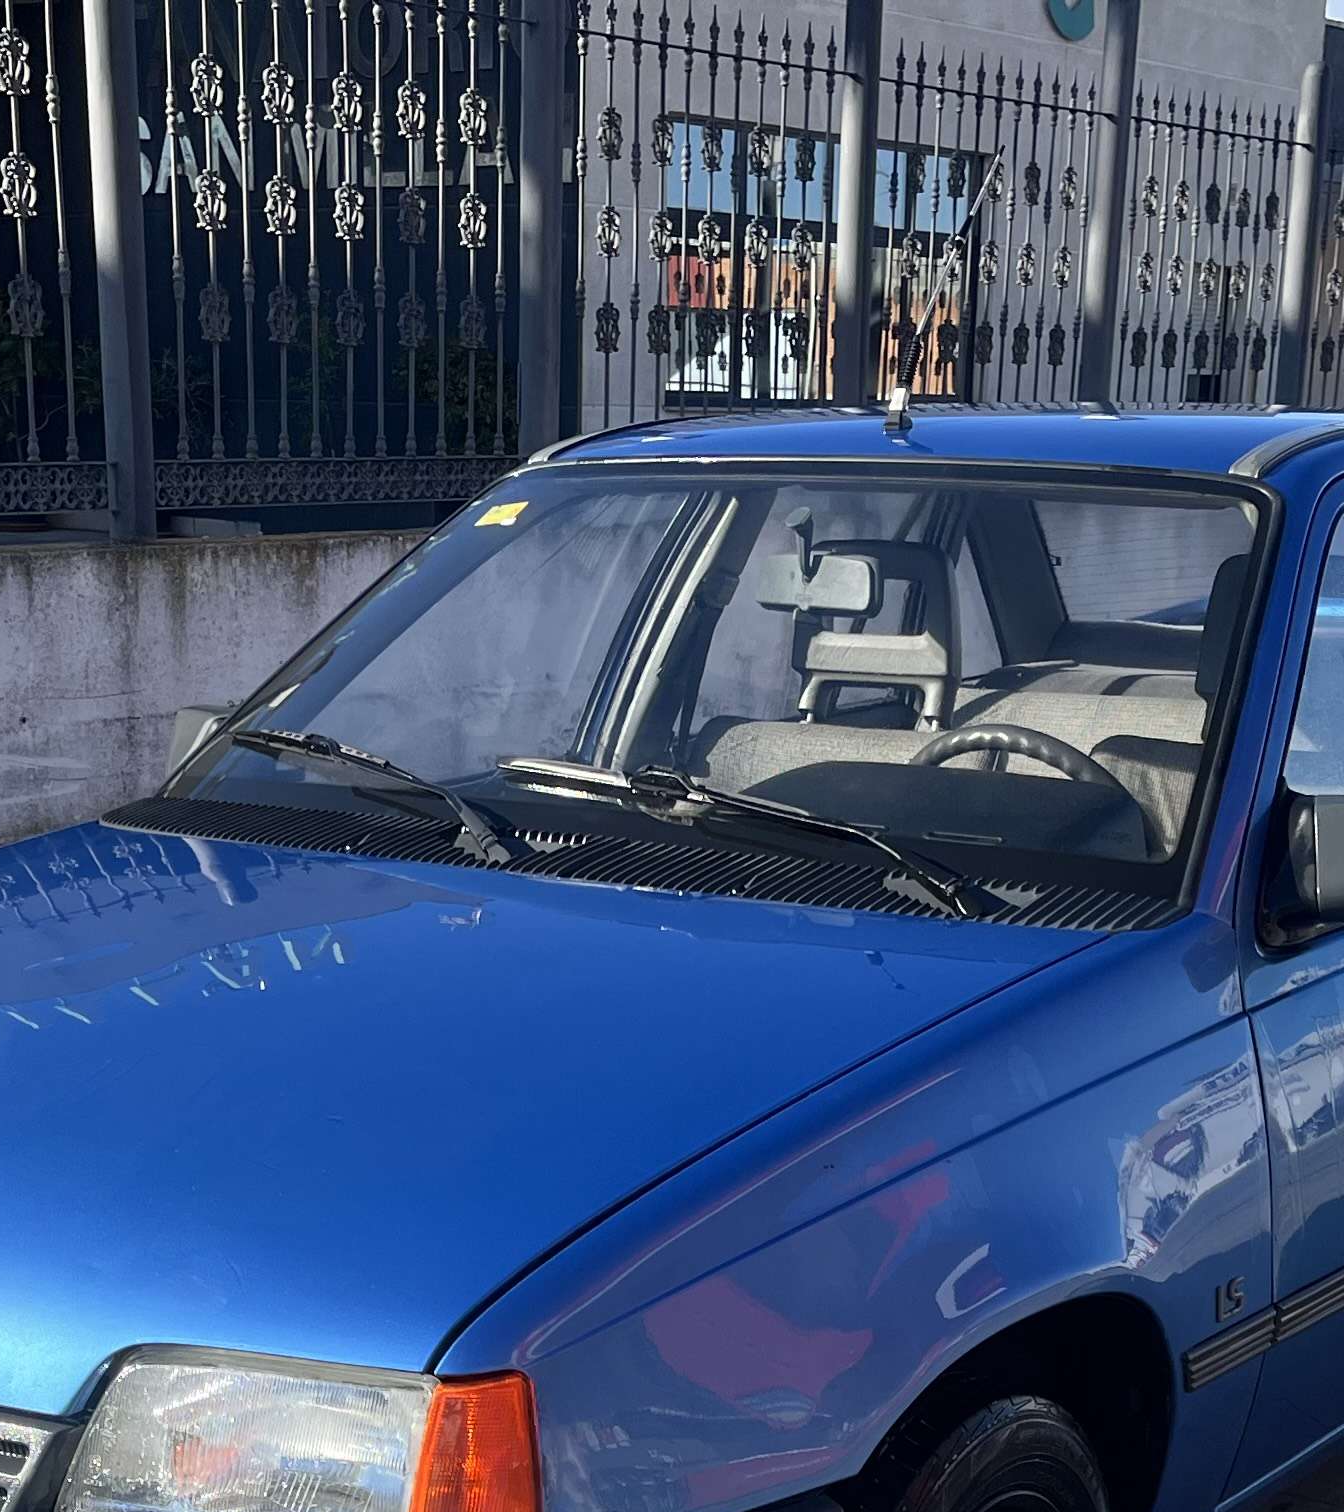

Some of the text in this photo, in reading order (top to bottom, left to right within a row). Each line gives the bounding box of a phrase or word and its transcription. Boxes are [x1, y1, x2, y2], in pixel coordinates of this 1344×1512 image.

[136, 0, 570, 86] ANATORI
[281, 93, 573, 191] MILLA
[1216, 1275, 1248, 1322] LS
